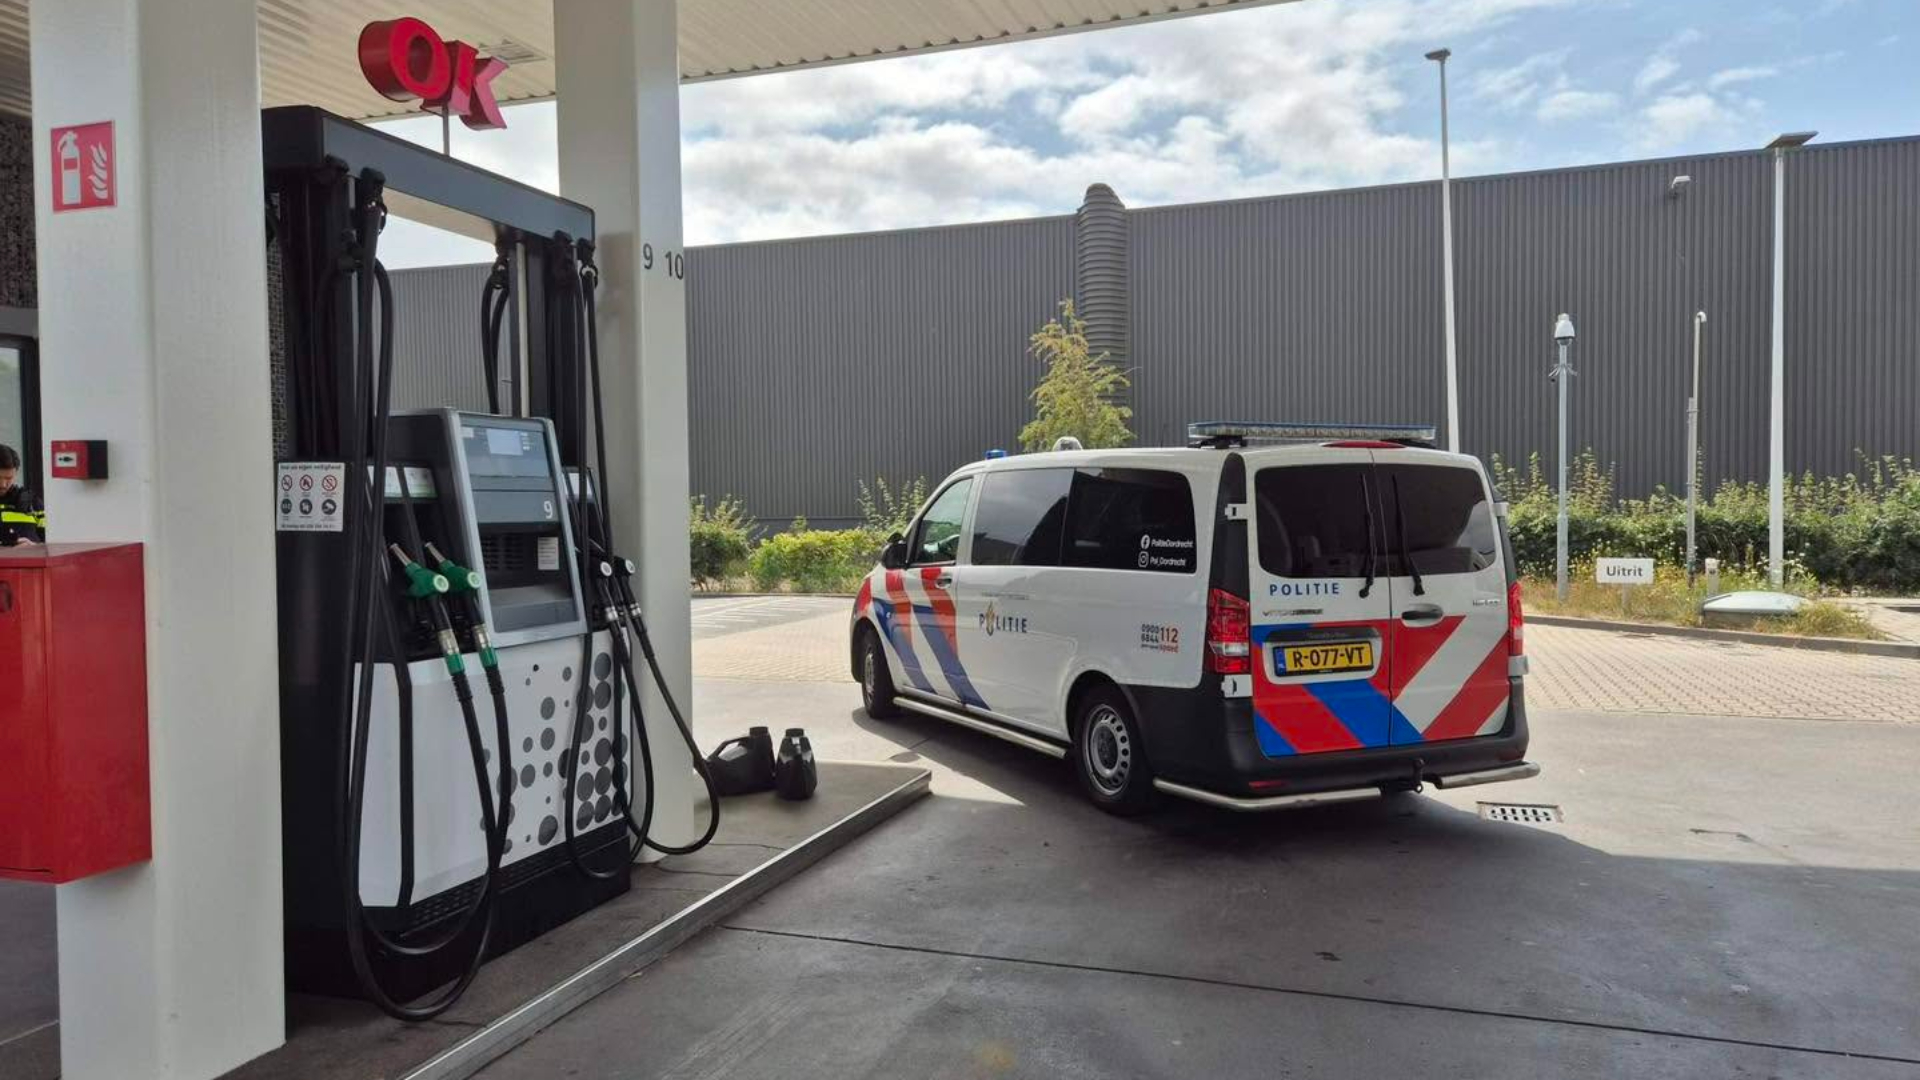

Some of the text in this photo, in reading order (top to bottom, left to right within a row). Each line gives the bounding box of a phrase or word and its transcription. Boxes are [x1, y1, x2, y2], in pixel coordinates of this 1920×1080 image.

[358, 17, 509, 131] OK
[642, 243, 684, 280] 9 10
[543, 500, 553, 519] 9
[1606, 566, 1643, 577] Uitrit
[1269, 582, 1340, 596] POLITIE
[1160, 626, 1179, 644] 112
[1292, 646, 1365, 668] R-077-VT
